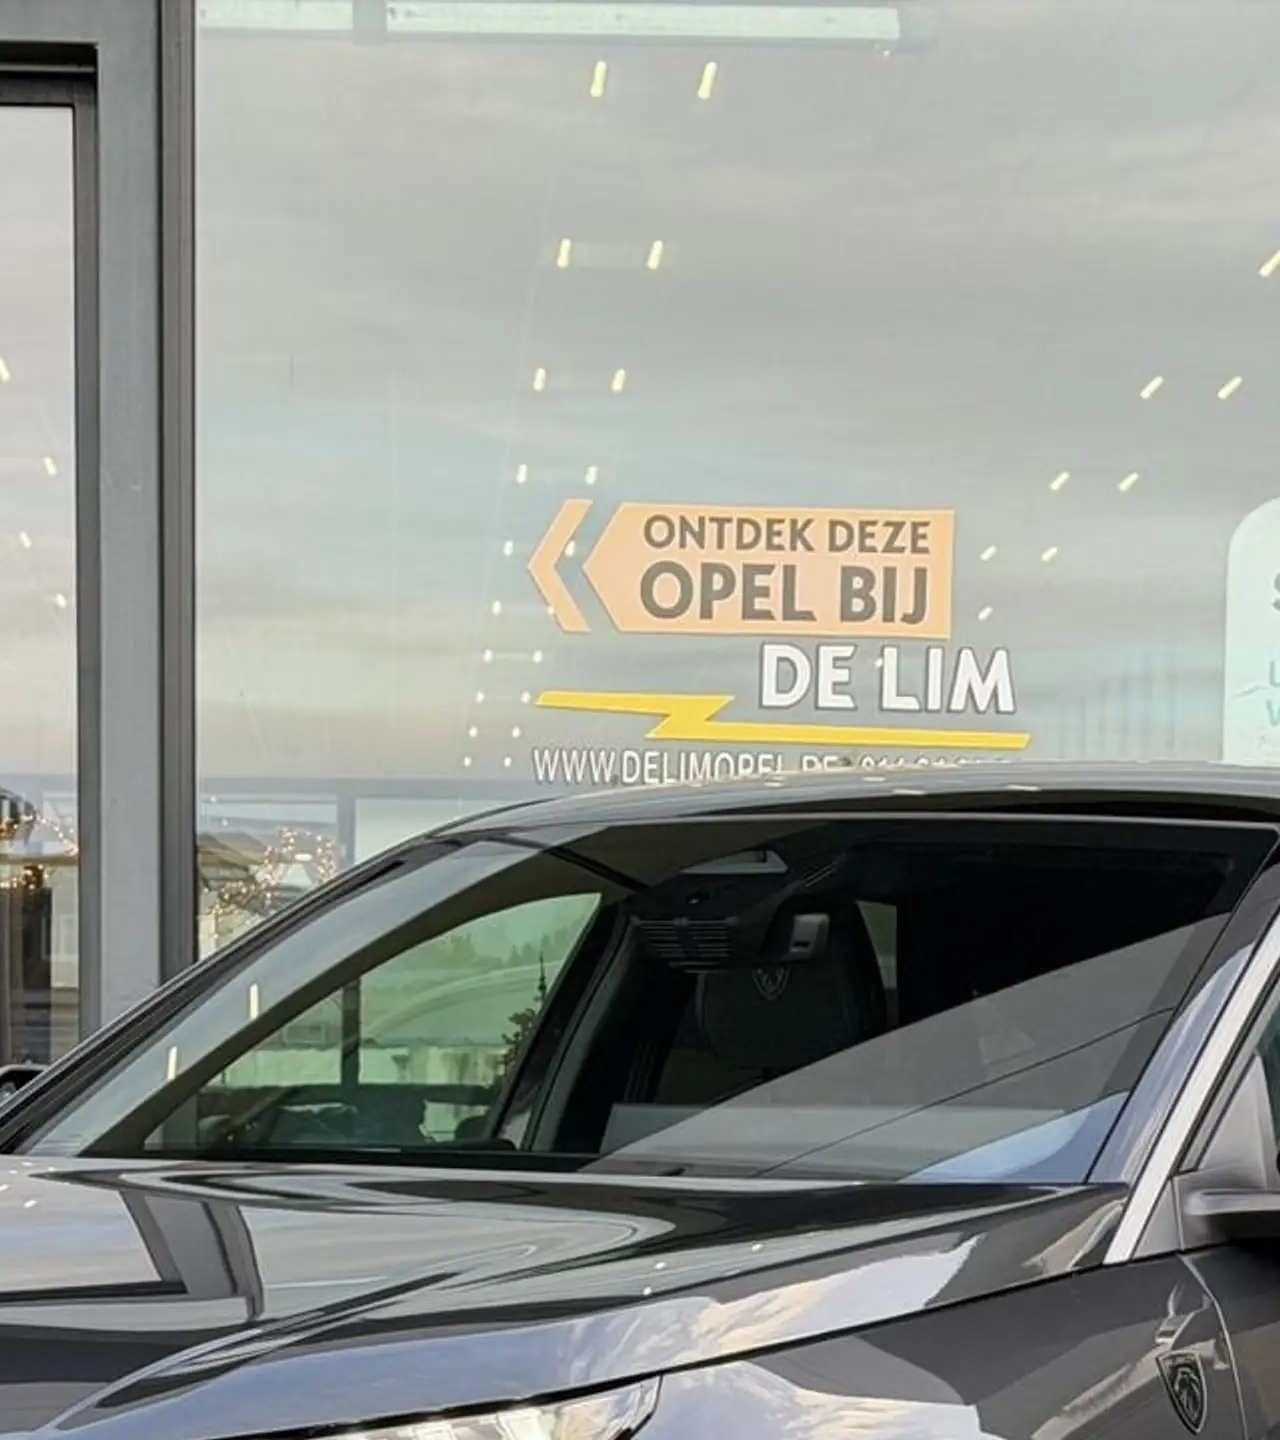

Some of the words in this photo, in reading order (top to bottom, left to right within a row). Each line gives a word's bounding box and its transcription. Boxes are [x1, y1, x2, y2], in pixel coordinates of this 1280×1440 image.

[643, 514, 814, 552] ONTDEK
[828, 519, 931, 555] DEZE
[640, 560, 816, 621] OPEL
[839, 565, 929, 625] BIJ
[759, 644, 858, 709] DE
[880, 646, 1017, 714] LIM
